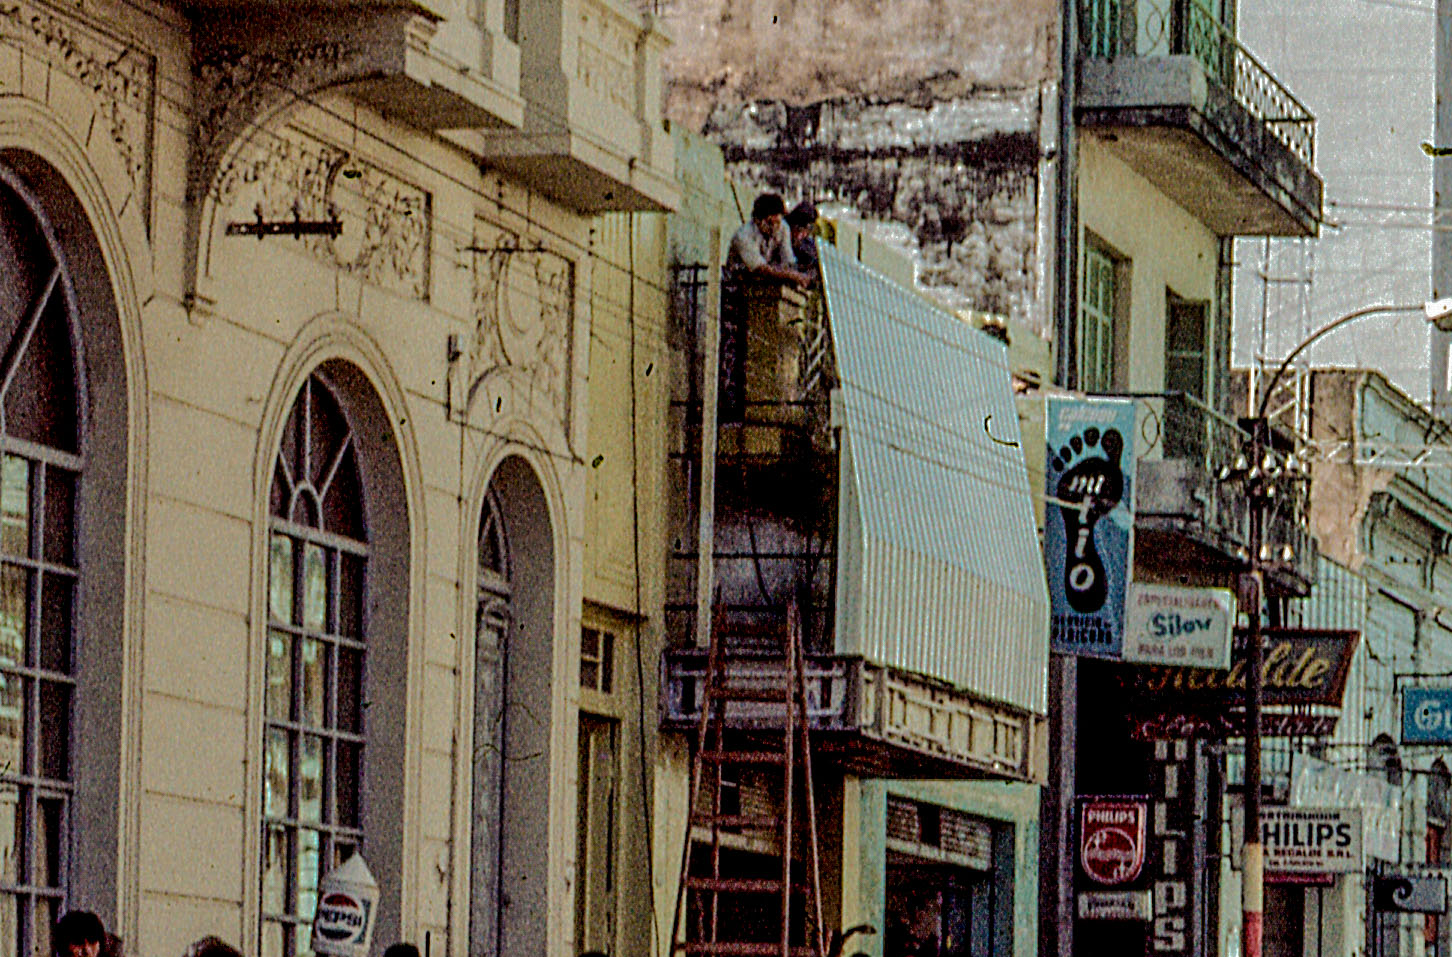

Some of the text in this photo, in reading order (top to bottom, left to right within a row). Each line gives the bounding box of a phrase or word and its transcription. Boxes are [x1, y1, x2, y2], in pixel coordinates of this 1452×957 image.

[1086, 809, 1136, 824] PHILIPS
[1154, 738, 1189, 951] HILIPS
[1262, 822, 1352, 847] HILIPS
[320, 908, 363, 928] PEPSI
